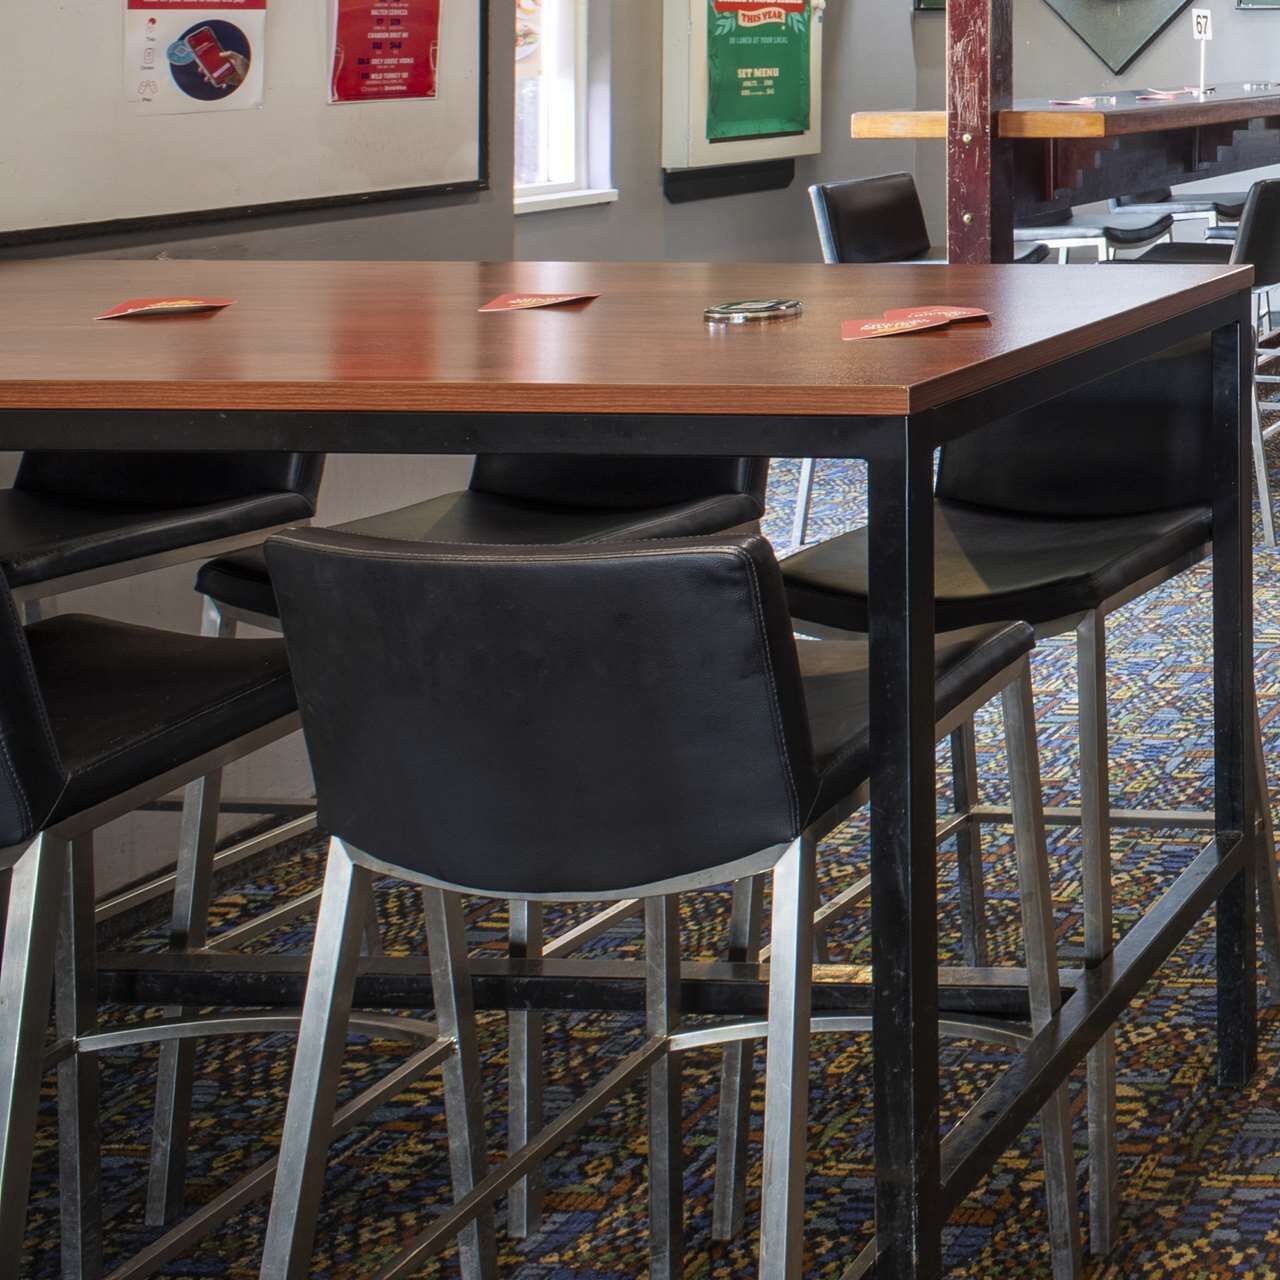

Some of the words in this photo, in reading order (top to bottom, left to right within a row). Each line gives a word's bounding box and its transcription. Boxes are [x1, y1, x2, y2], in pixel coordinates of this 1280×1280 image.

[741, 13, 761, 24] THIS
[762, 11, 784, 21] YEAR
[1196, 14, 1208, 35] 67
[737, 69, 753, 79] SET
[753, 68, 780, 78] MENU
